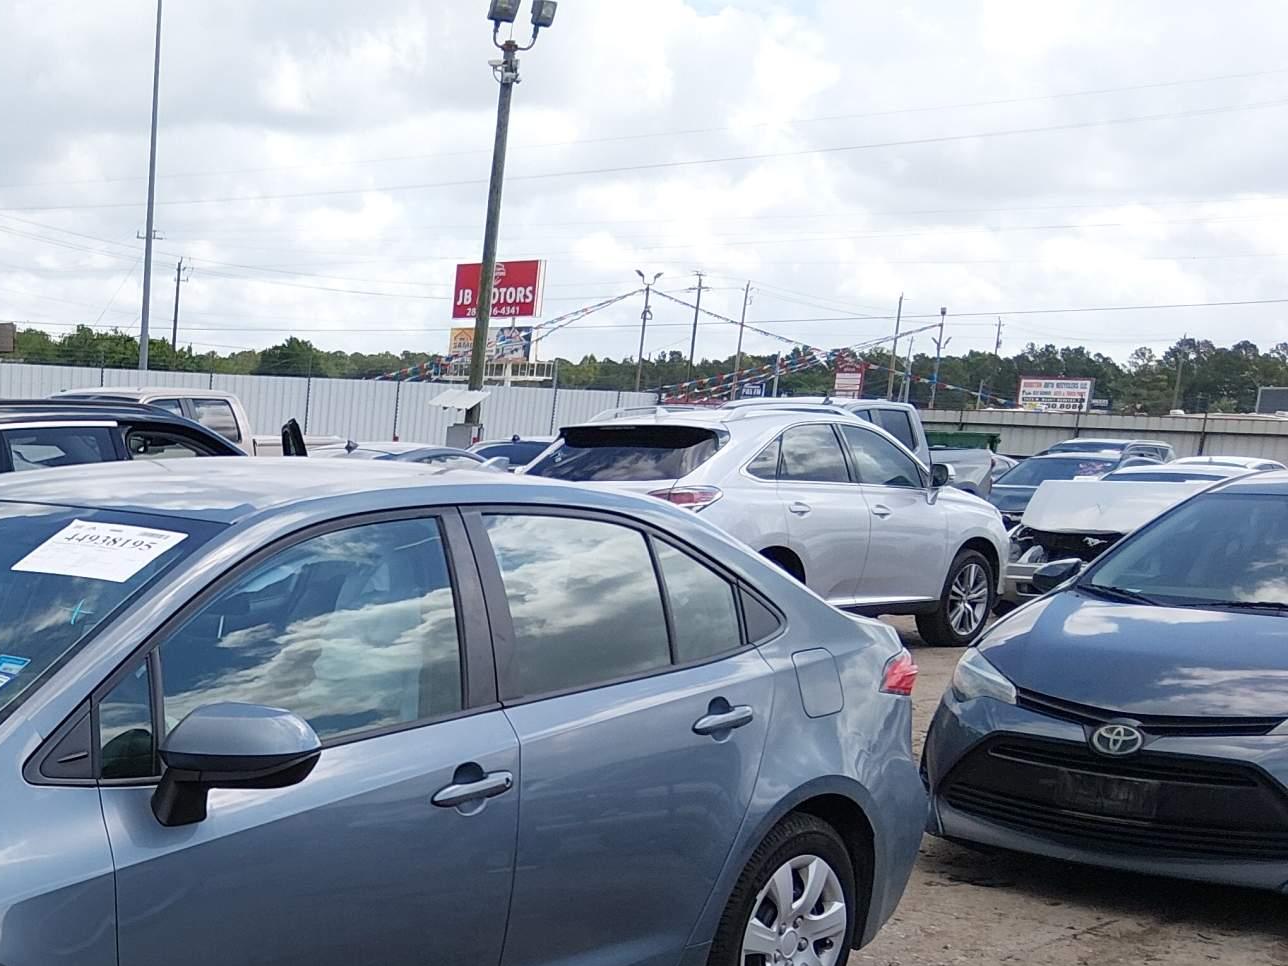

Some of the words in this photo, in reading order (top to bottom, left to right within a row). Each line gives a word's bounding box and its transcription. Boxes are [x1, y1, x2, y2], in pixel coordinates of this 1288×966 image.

[456, 289, 472, 305] JB
[476, 287, 533, 304] OTORS
[64, 532, 158, 551] 44938195
